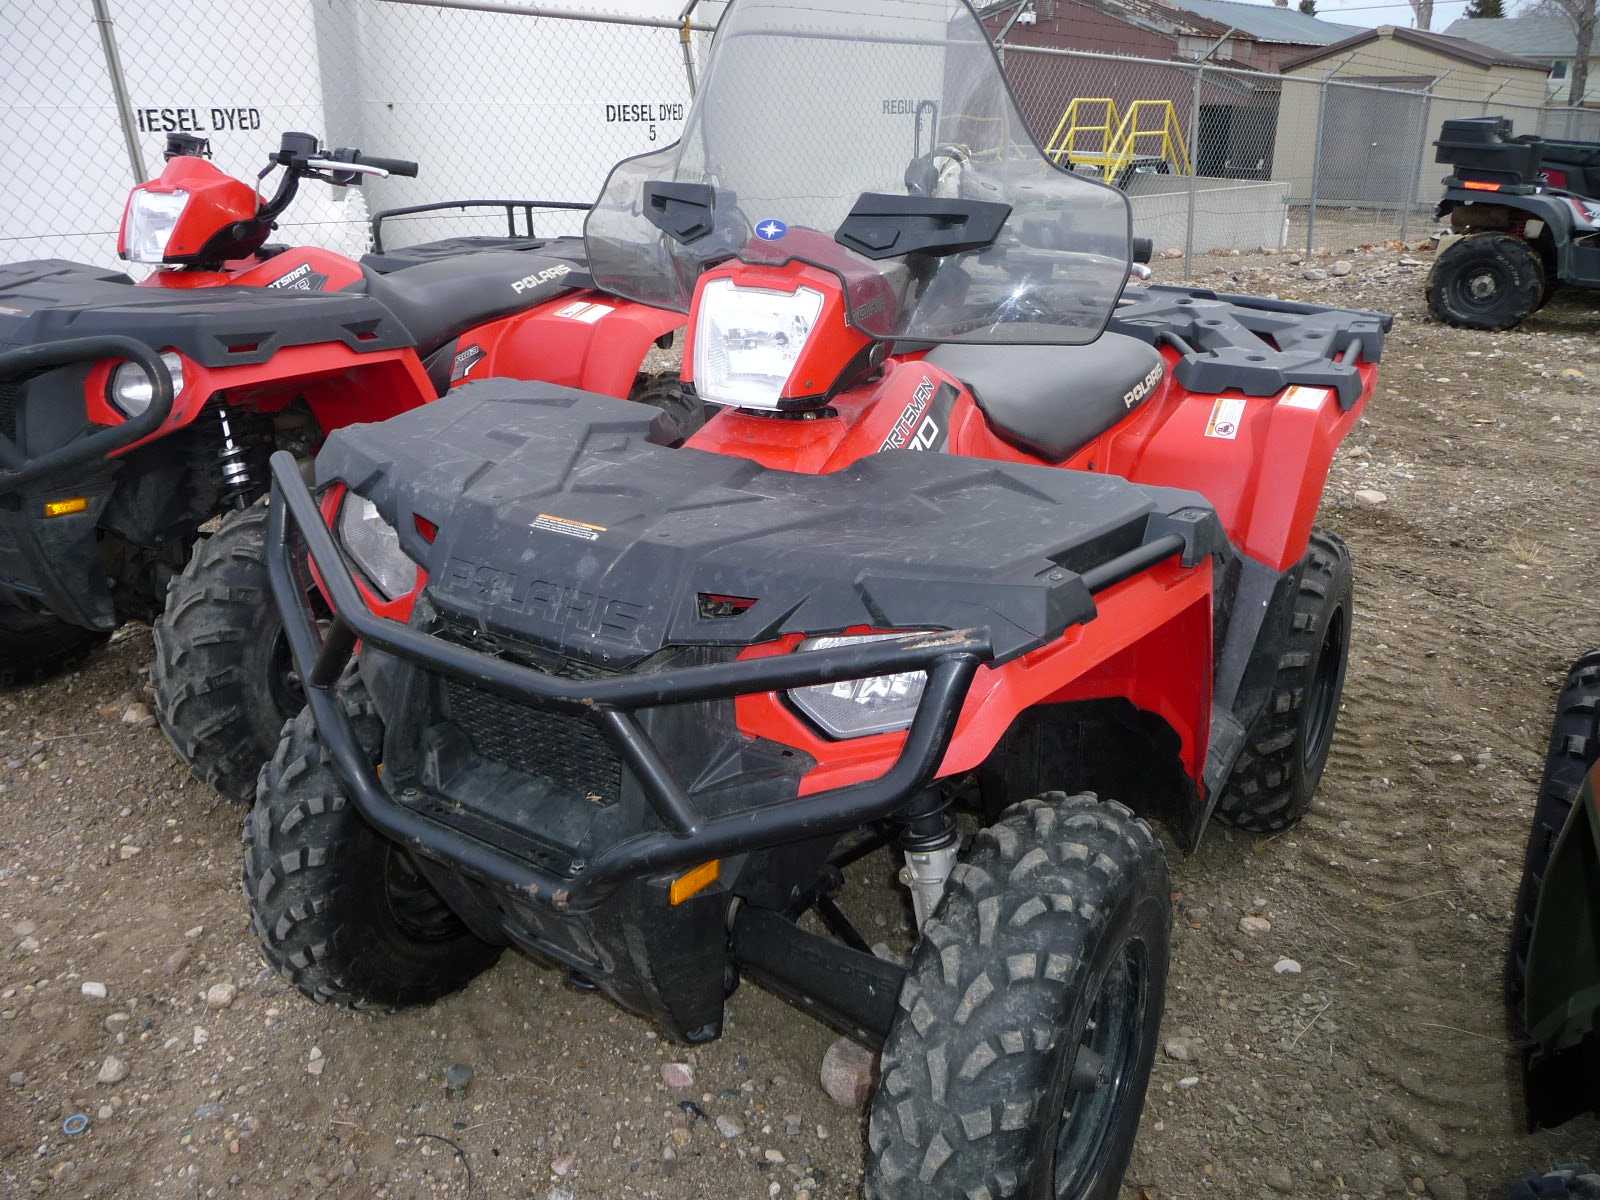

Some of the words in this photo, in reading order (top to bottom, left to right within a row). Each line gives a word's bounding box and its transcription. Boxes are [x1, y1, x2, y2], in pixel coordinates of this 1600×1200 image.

[137, 108, 206, 132] IESEL
[211, 108, 260, 131] DYED
[606, 104, 656, 122] DIESEL
[659, 104, 684, 121] DYED
[649, 124, 657, 141] 5
[511, 264, 572, 294] POLARIS
[1123, 361, 1163, 409] POLARIS
[445, 555, 647, 645] POLARIS
